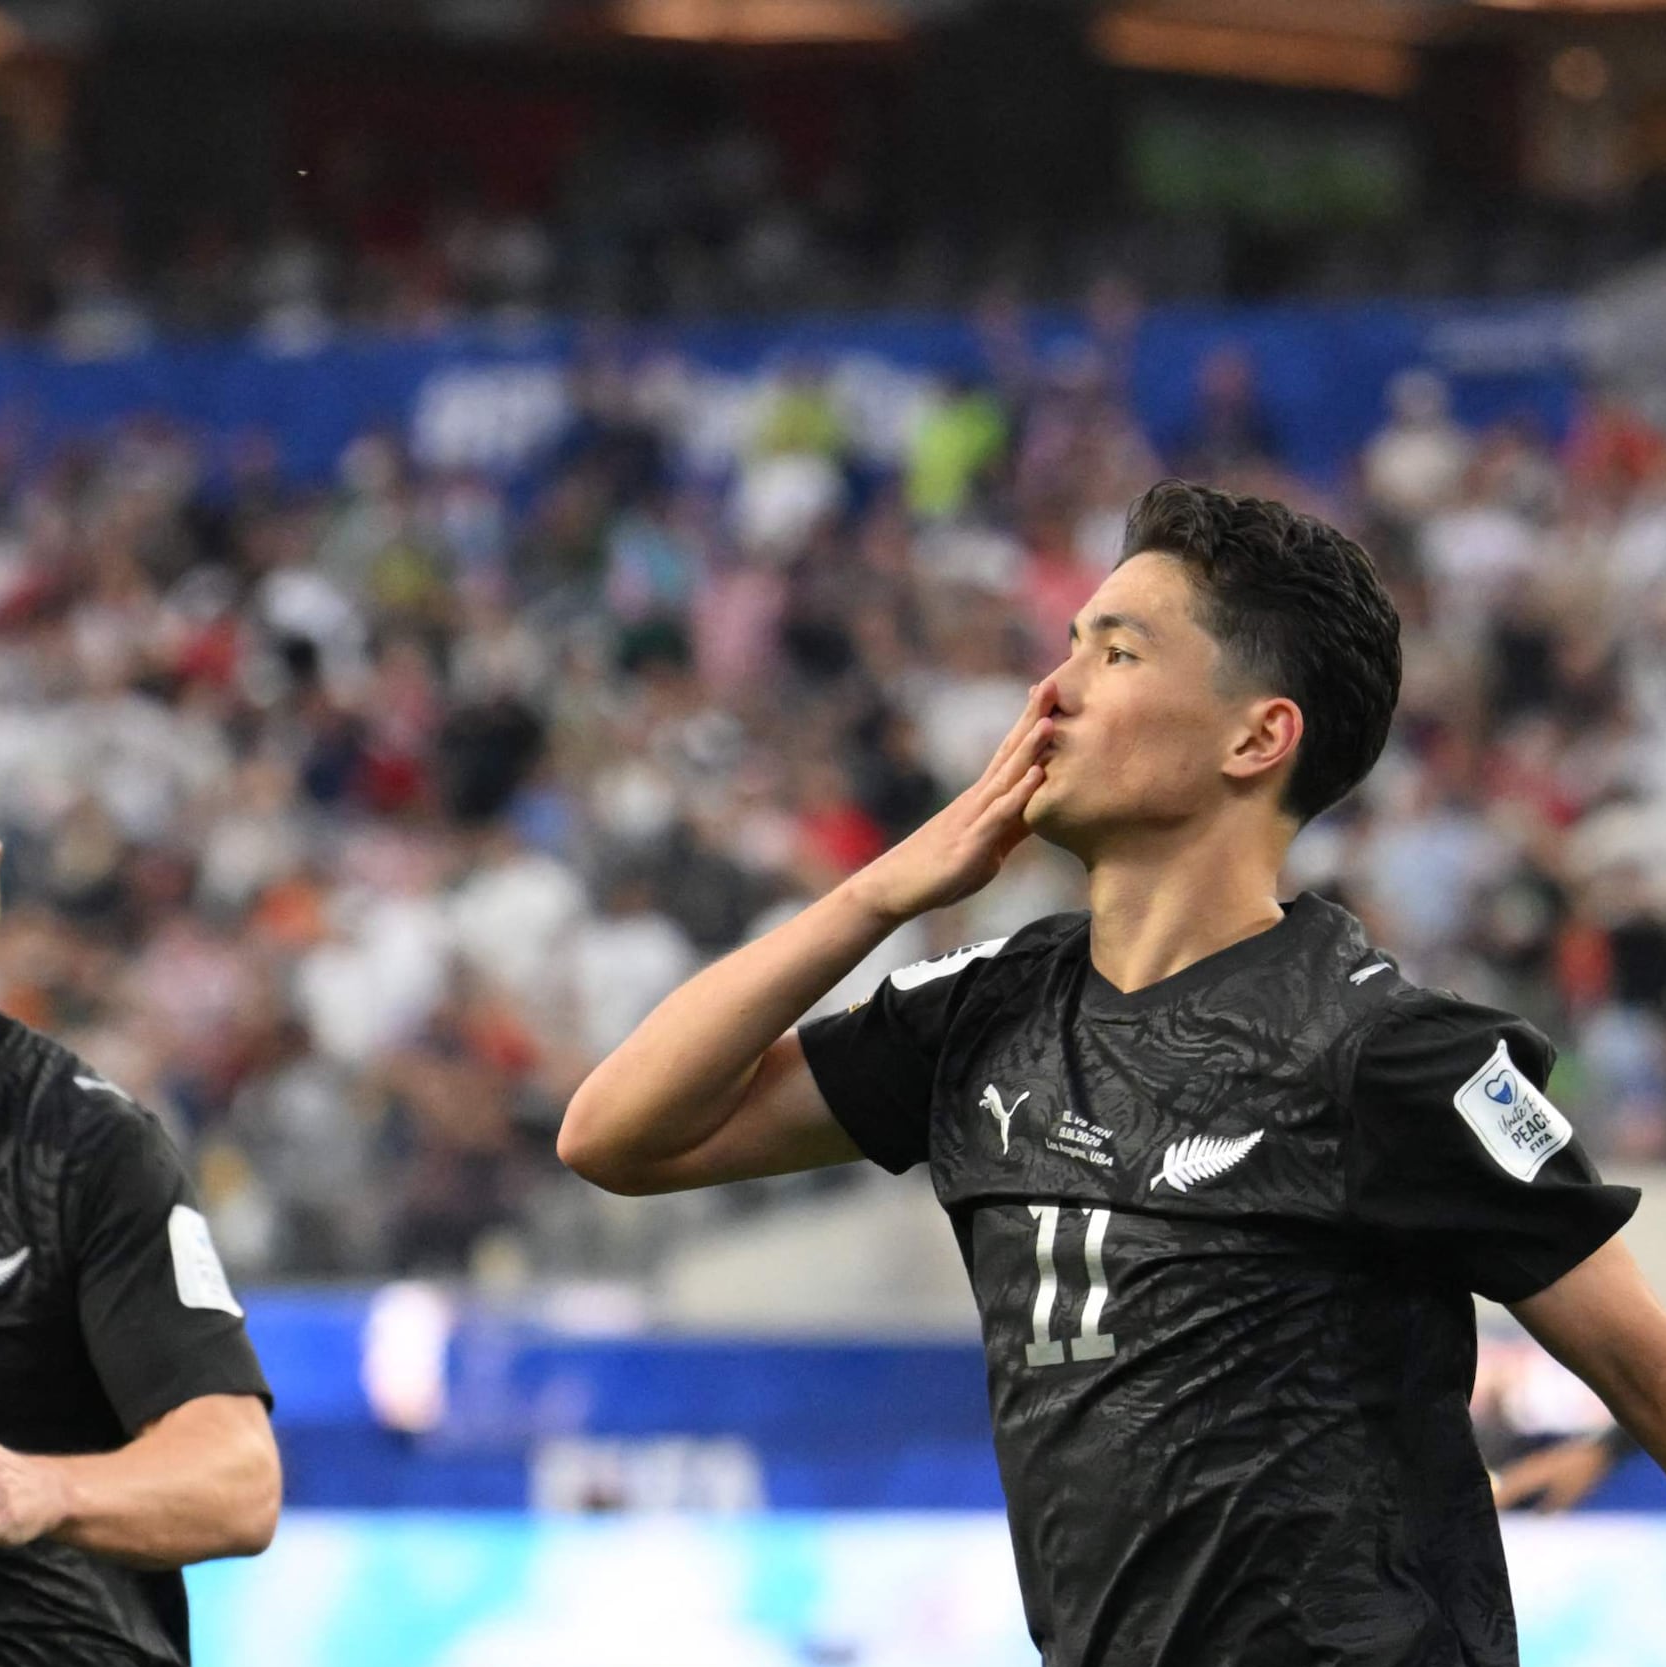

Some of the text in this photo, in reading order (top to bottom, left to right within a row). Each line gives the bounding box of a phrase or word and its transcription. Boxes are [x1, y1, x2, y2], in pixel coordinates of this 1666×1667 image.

[1529, 1133, 1553, 1153] FIFA
[1089, 1151, 1114, 1167] USA
[1025, 1205, 1117, 1367] 11
